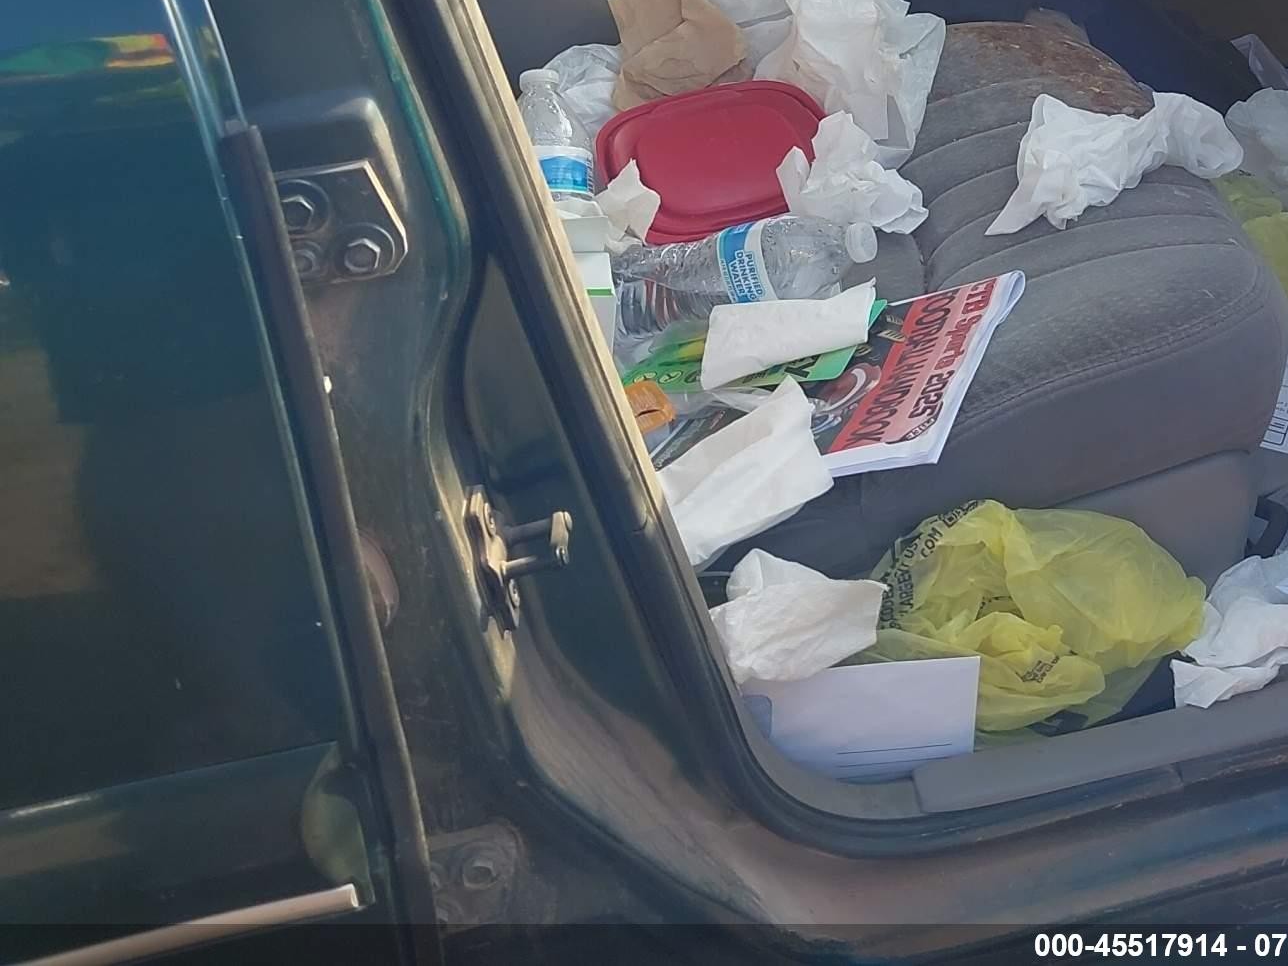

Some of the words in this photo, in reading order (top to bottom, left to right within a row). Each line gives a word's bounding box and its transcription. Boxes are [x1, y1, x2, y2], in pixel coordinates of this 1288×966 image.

[729, 261, 746, 294] WATER
[735, 250, 758, 300] DRINKING
[745, 252, 764, 296] PURIFIED
[895, 288, 960, 367] FOOTBALL
[934, 313, 984, 371] Sports
[846, 361, 926, 443] HANDBOOK
[908, 369, 955, 420] 2025
